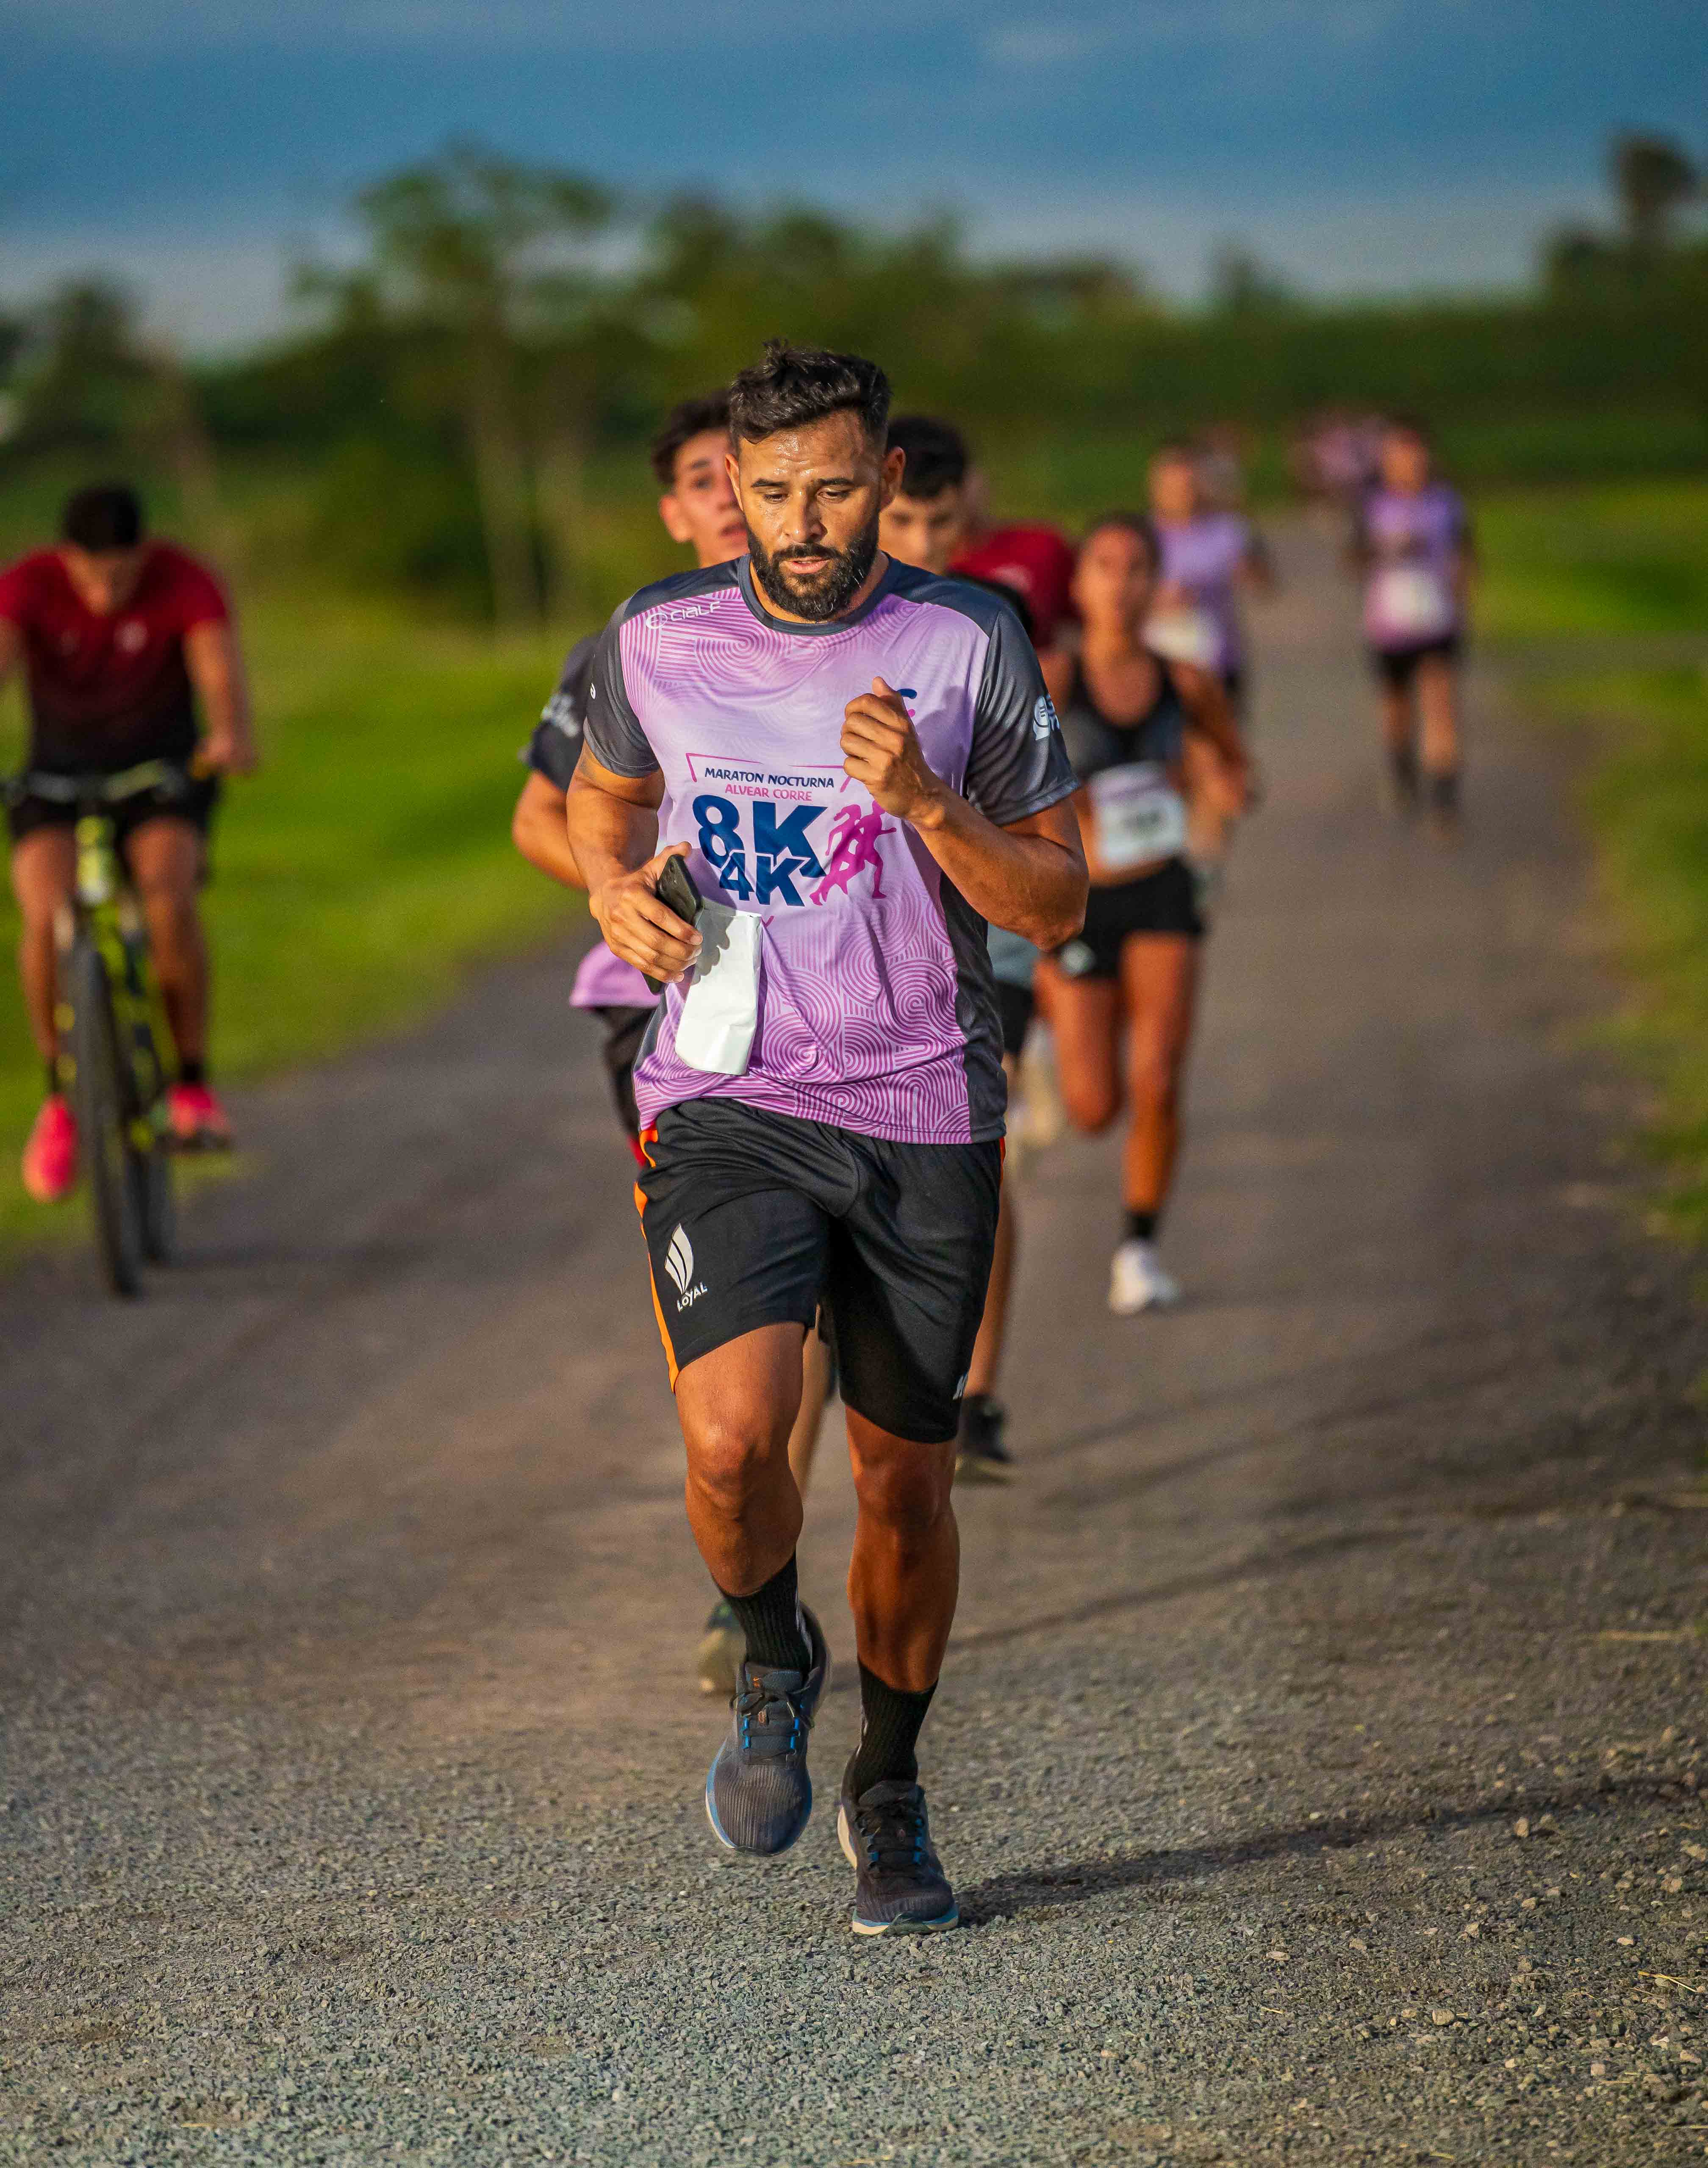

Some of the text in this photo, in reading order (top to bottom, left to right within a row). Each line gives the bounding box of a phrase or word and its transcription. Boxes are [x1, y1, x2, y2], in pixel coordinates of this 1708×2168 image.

[704, 768, 834, 787] MARATON NOCTURNA
[725, 784, 812, 801] ALVEAR CORRE
[692, 794, 828, 877] 8K
[720, 852, 806, 907] 4K
[677, 1282, 708, 1311] LOYAL
